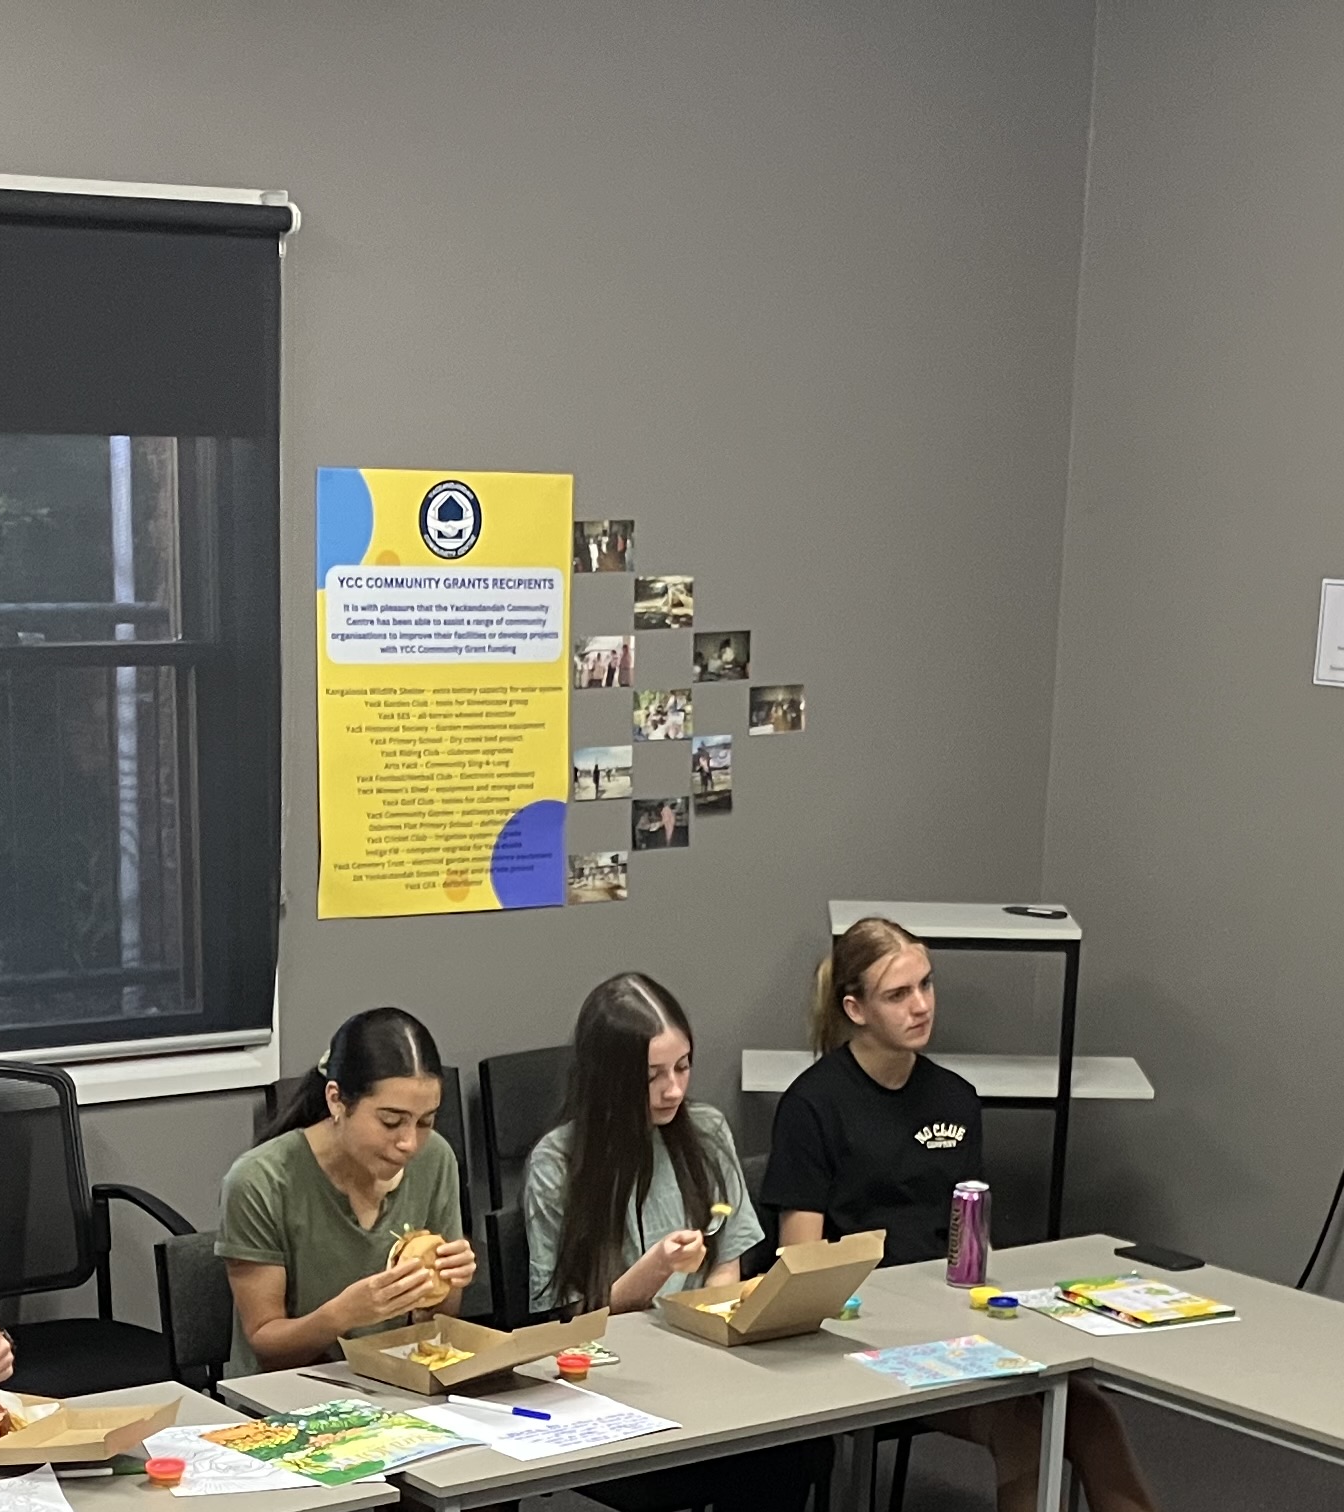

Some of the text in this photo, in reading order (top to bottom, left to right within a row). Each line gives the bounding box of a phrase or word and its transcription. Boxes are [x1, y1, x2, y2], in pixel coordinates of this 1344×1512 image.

[337, 576, 554, 591] YCC COMMUNITY GRANTS RECIPIENTS
[343, 604, 349, 613] It
[360, 604, 378, 613] with
[380, 605, 414, 615] pleasure
[416, 604, 433, 613] that
[435, 604, 447, 613] the
[507, 604, 548, 615] Community
[346, 616, 373, 626] Centre
[376, 616, 389, 626] has
[392, 616, 412, 626] been
[414, 616, 431, 626] able
[433, 617, 441, 627] to
[443, 616, 464, 626] assist
[472, 618, 493, 628] range
[495, 616, 503, 626] of
[504, 617, 546, 628] community
[331, 632, 386, 643] organisations
[388, 631, 397, 640] to
[399, 631, 432, 642] improve
[434, 631, 451, 641] their
[488, 632, 496, 641] or
[498, 631, 527, 642] develop
[529, 631, 558, 642] projects
[380, 644, 516, 655] with YCC Community Grant funding
[932, 1122, 967, 1142] CLUE
